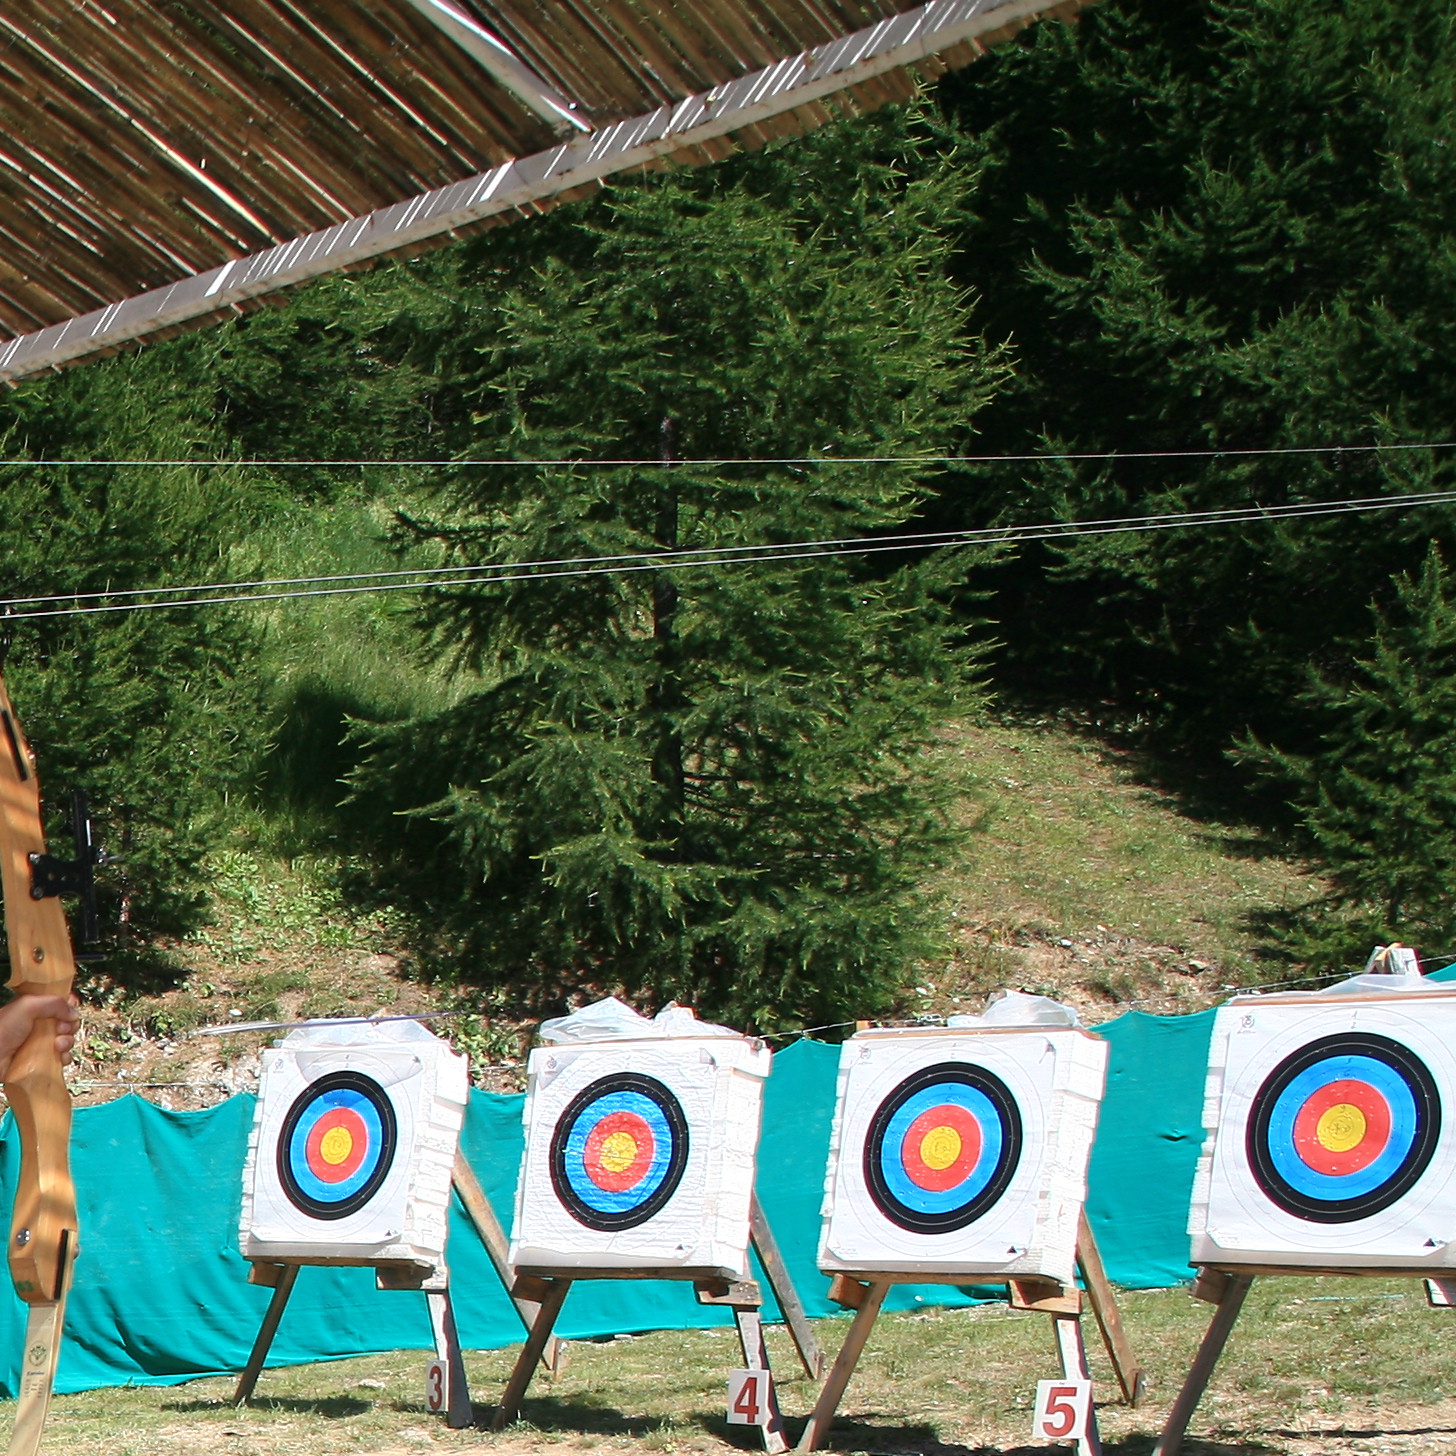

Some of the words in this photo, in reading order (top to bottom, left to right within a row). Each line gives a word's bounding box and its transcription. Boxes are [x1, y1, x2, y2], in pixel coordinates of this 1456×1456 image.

[429, 1365, 443, 1410] 3
[734, 1376, 760, 1424] 4
[1042, 1386, 1078, 1437] 5
